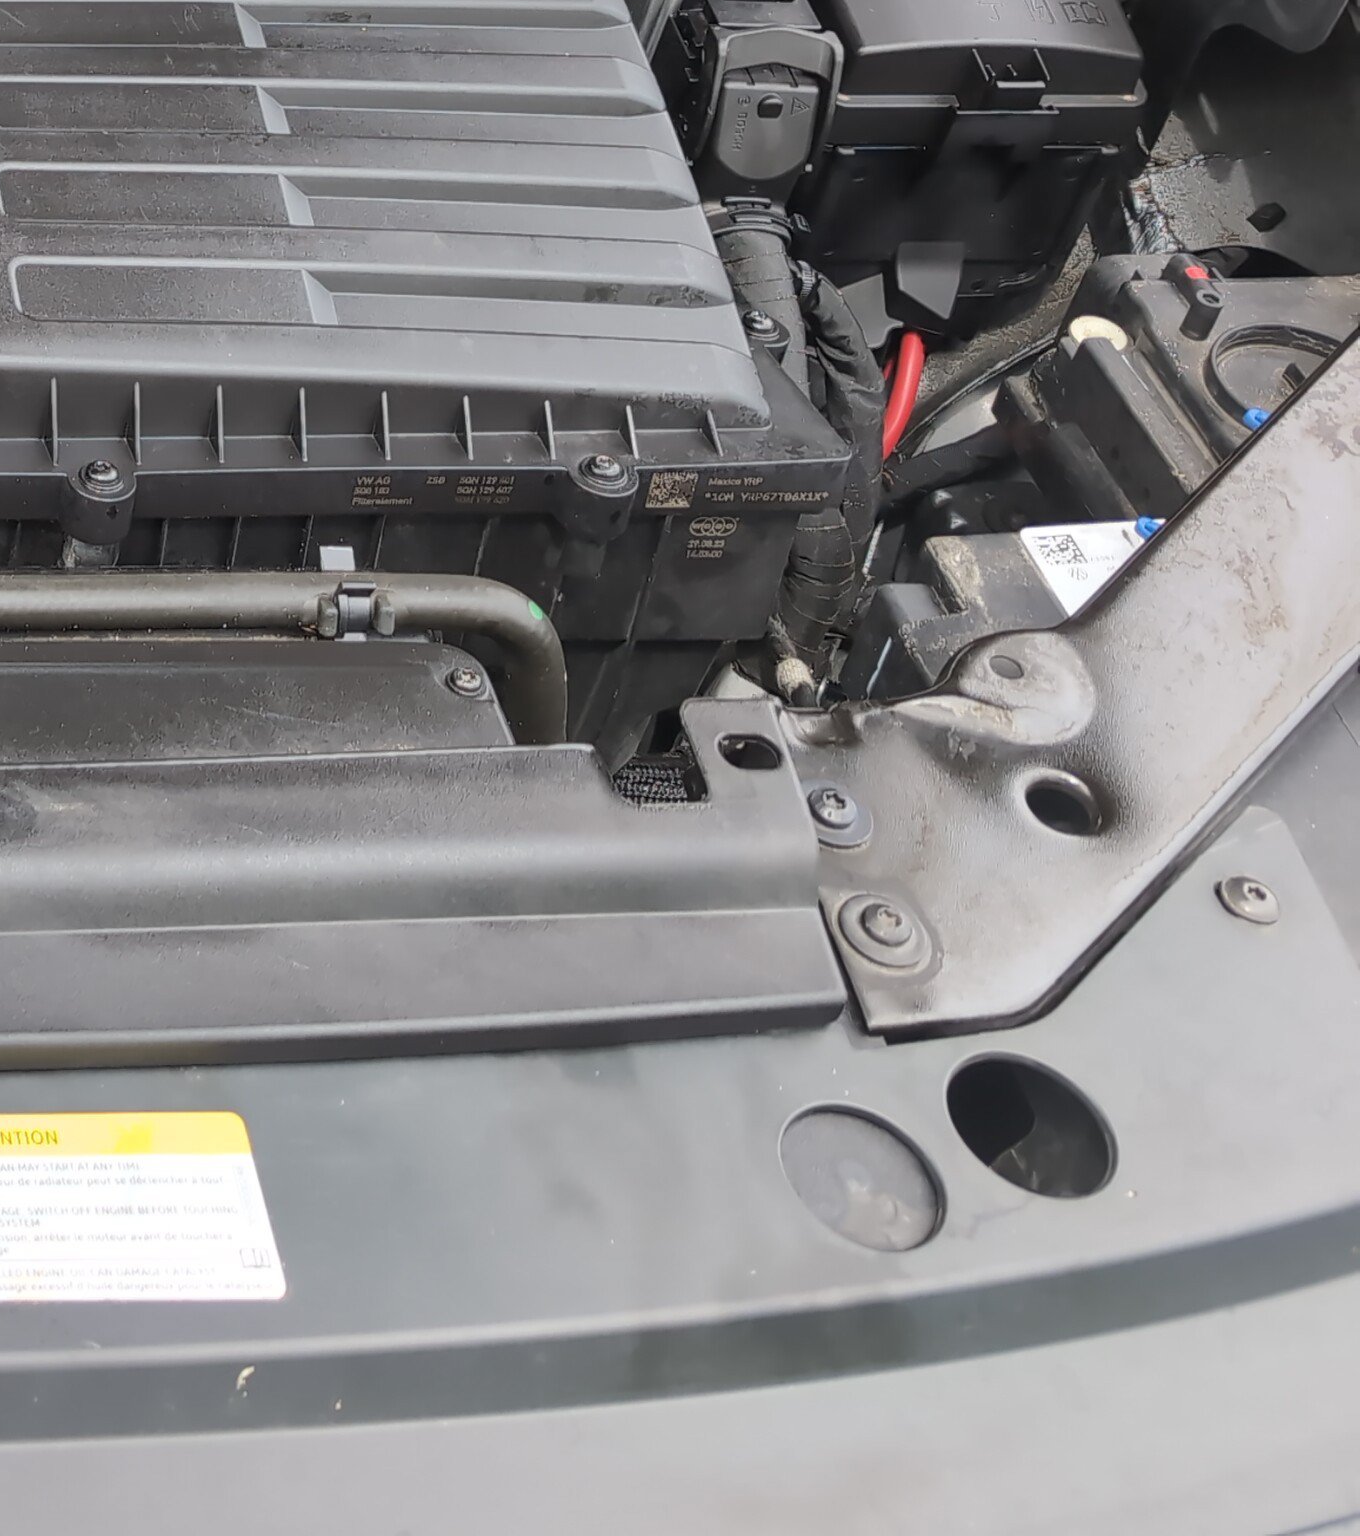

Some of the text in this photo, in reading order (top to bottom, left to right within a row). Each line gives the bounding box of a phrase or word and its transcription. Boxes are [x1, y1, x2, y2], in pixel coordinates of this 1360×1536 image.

[357, 476, 374, 485] VW
[18, 1163, 39, 1172] MAY
[43, 1163, 74, 1172] START
[93, 1163, 112, 1171] ANY
[18, 1178, 31, 1186] de
[35, 1178, 82, 1187] radiateur
[87, 1178, 111, 1188] peut
[201, 1176, 223, 1185] tout
[0, 1219, 41, 1227] SYSTEM
